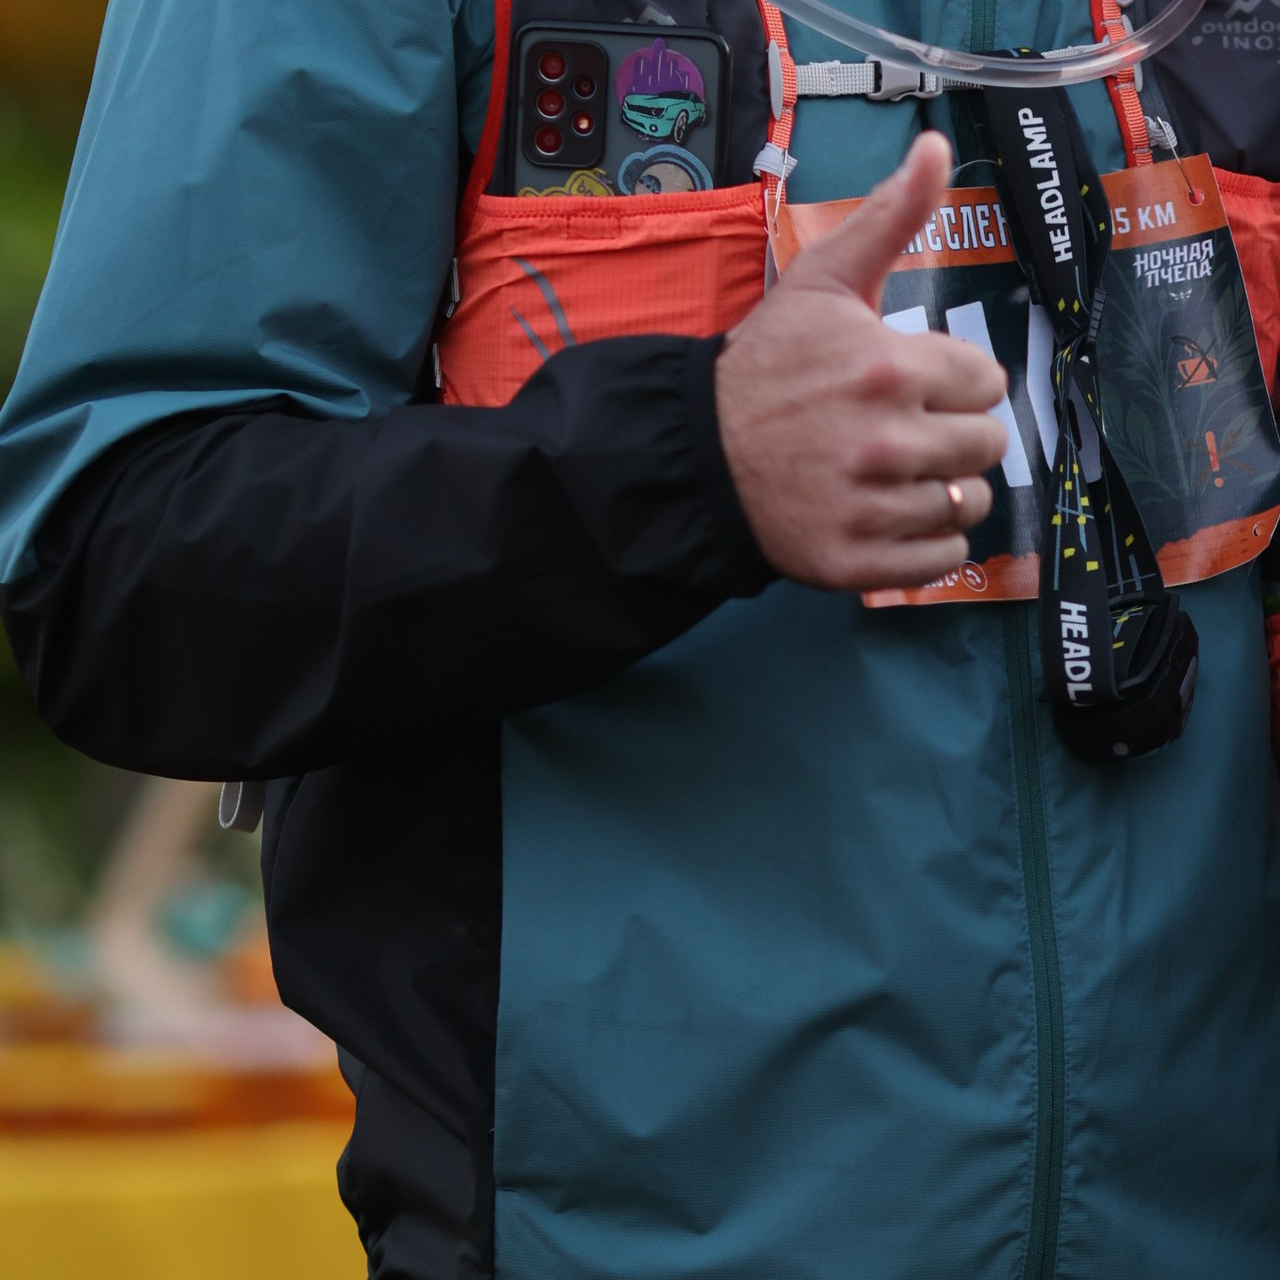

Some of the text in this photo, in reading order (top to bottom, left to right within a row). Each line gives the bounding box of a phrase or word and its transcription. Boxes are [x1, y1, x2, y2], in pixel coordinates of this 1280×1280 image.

[1018, 107, 1074, 264] HEADLAMP
[1133, 239, 1215, 278] НОЧНАЯ
[1144, 259, 1212, 288] ПЧЕЛА
